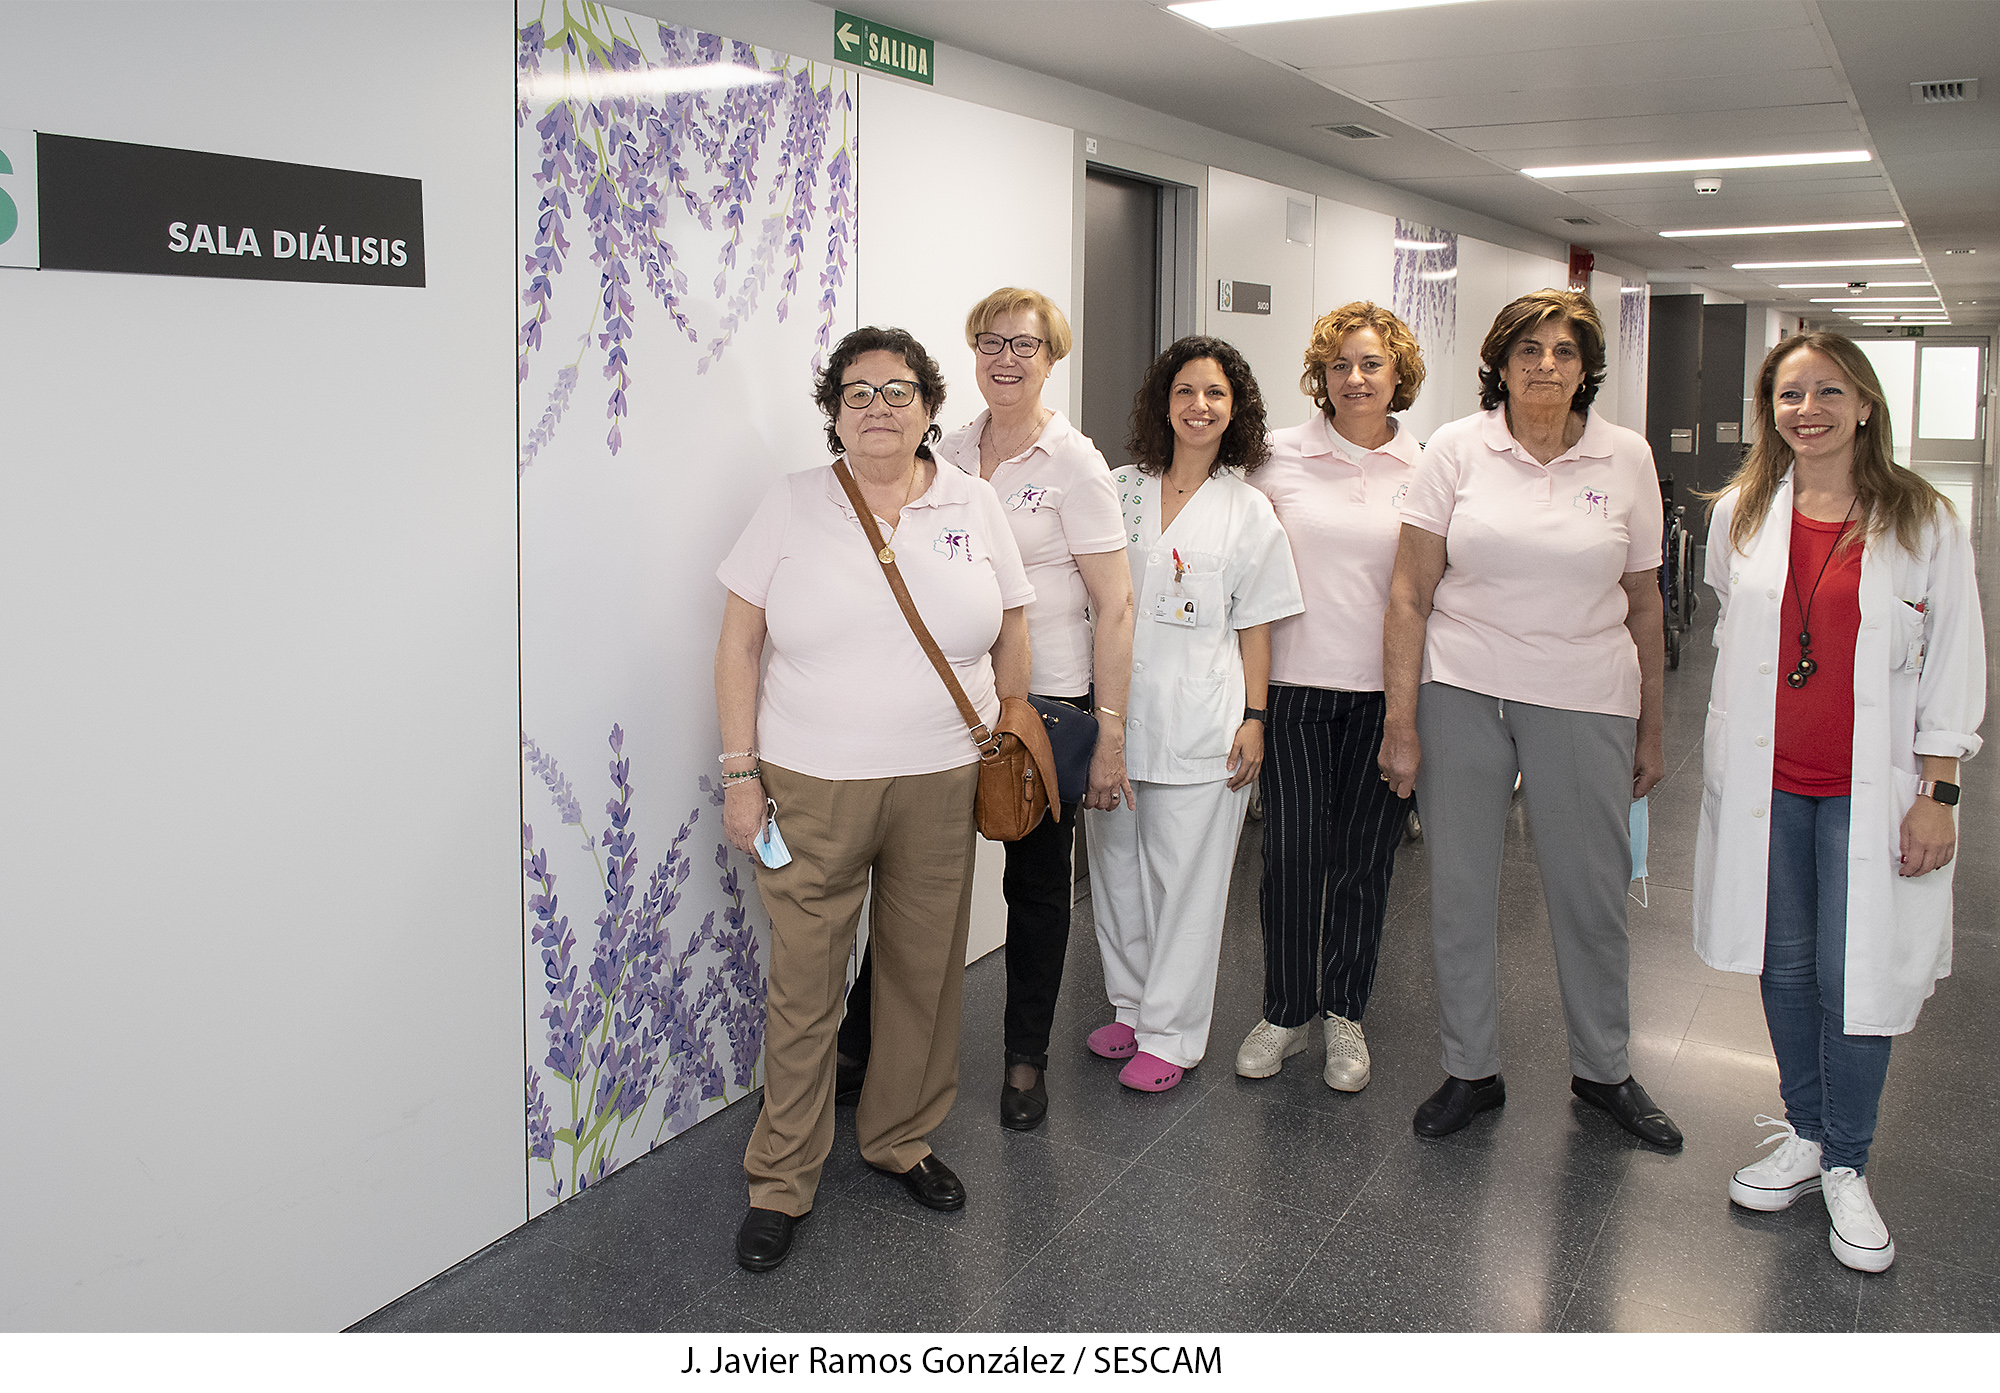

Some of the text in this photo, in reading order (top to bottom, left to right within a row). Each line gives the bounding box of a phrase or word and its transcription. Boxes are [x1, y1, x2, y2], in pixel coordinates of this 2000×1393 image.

[868, 33, 928, 75] SALIDA
[167, 221, 408, 267] SALA DIÁLISIS
